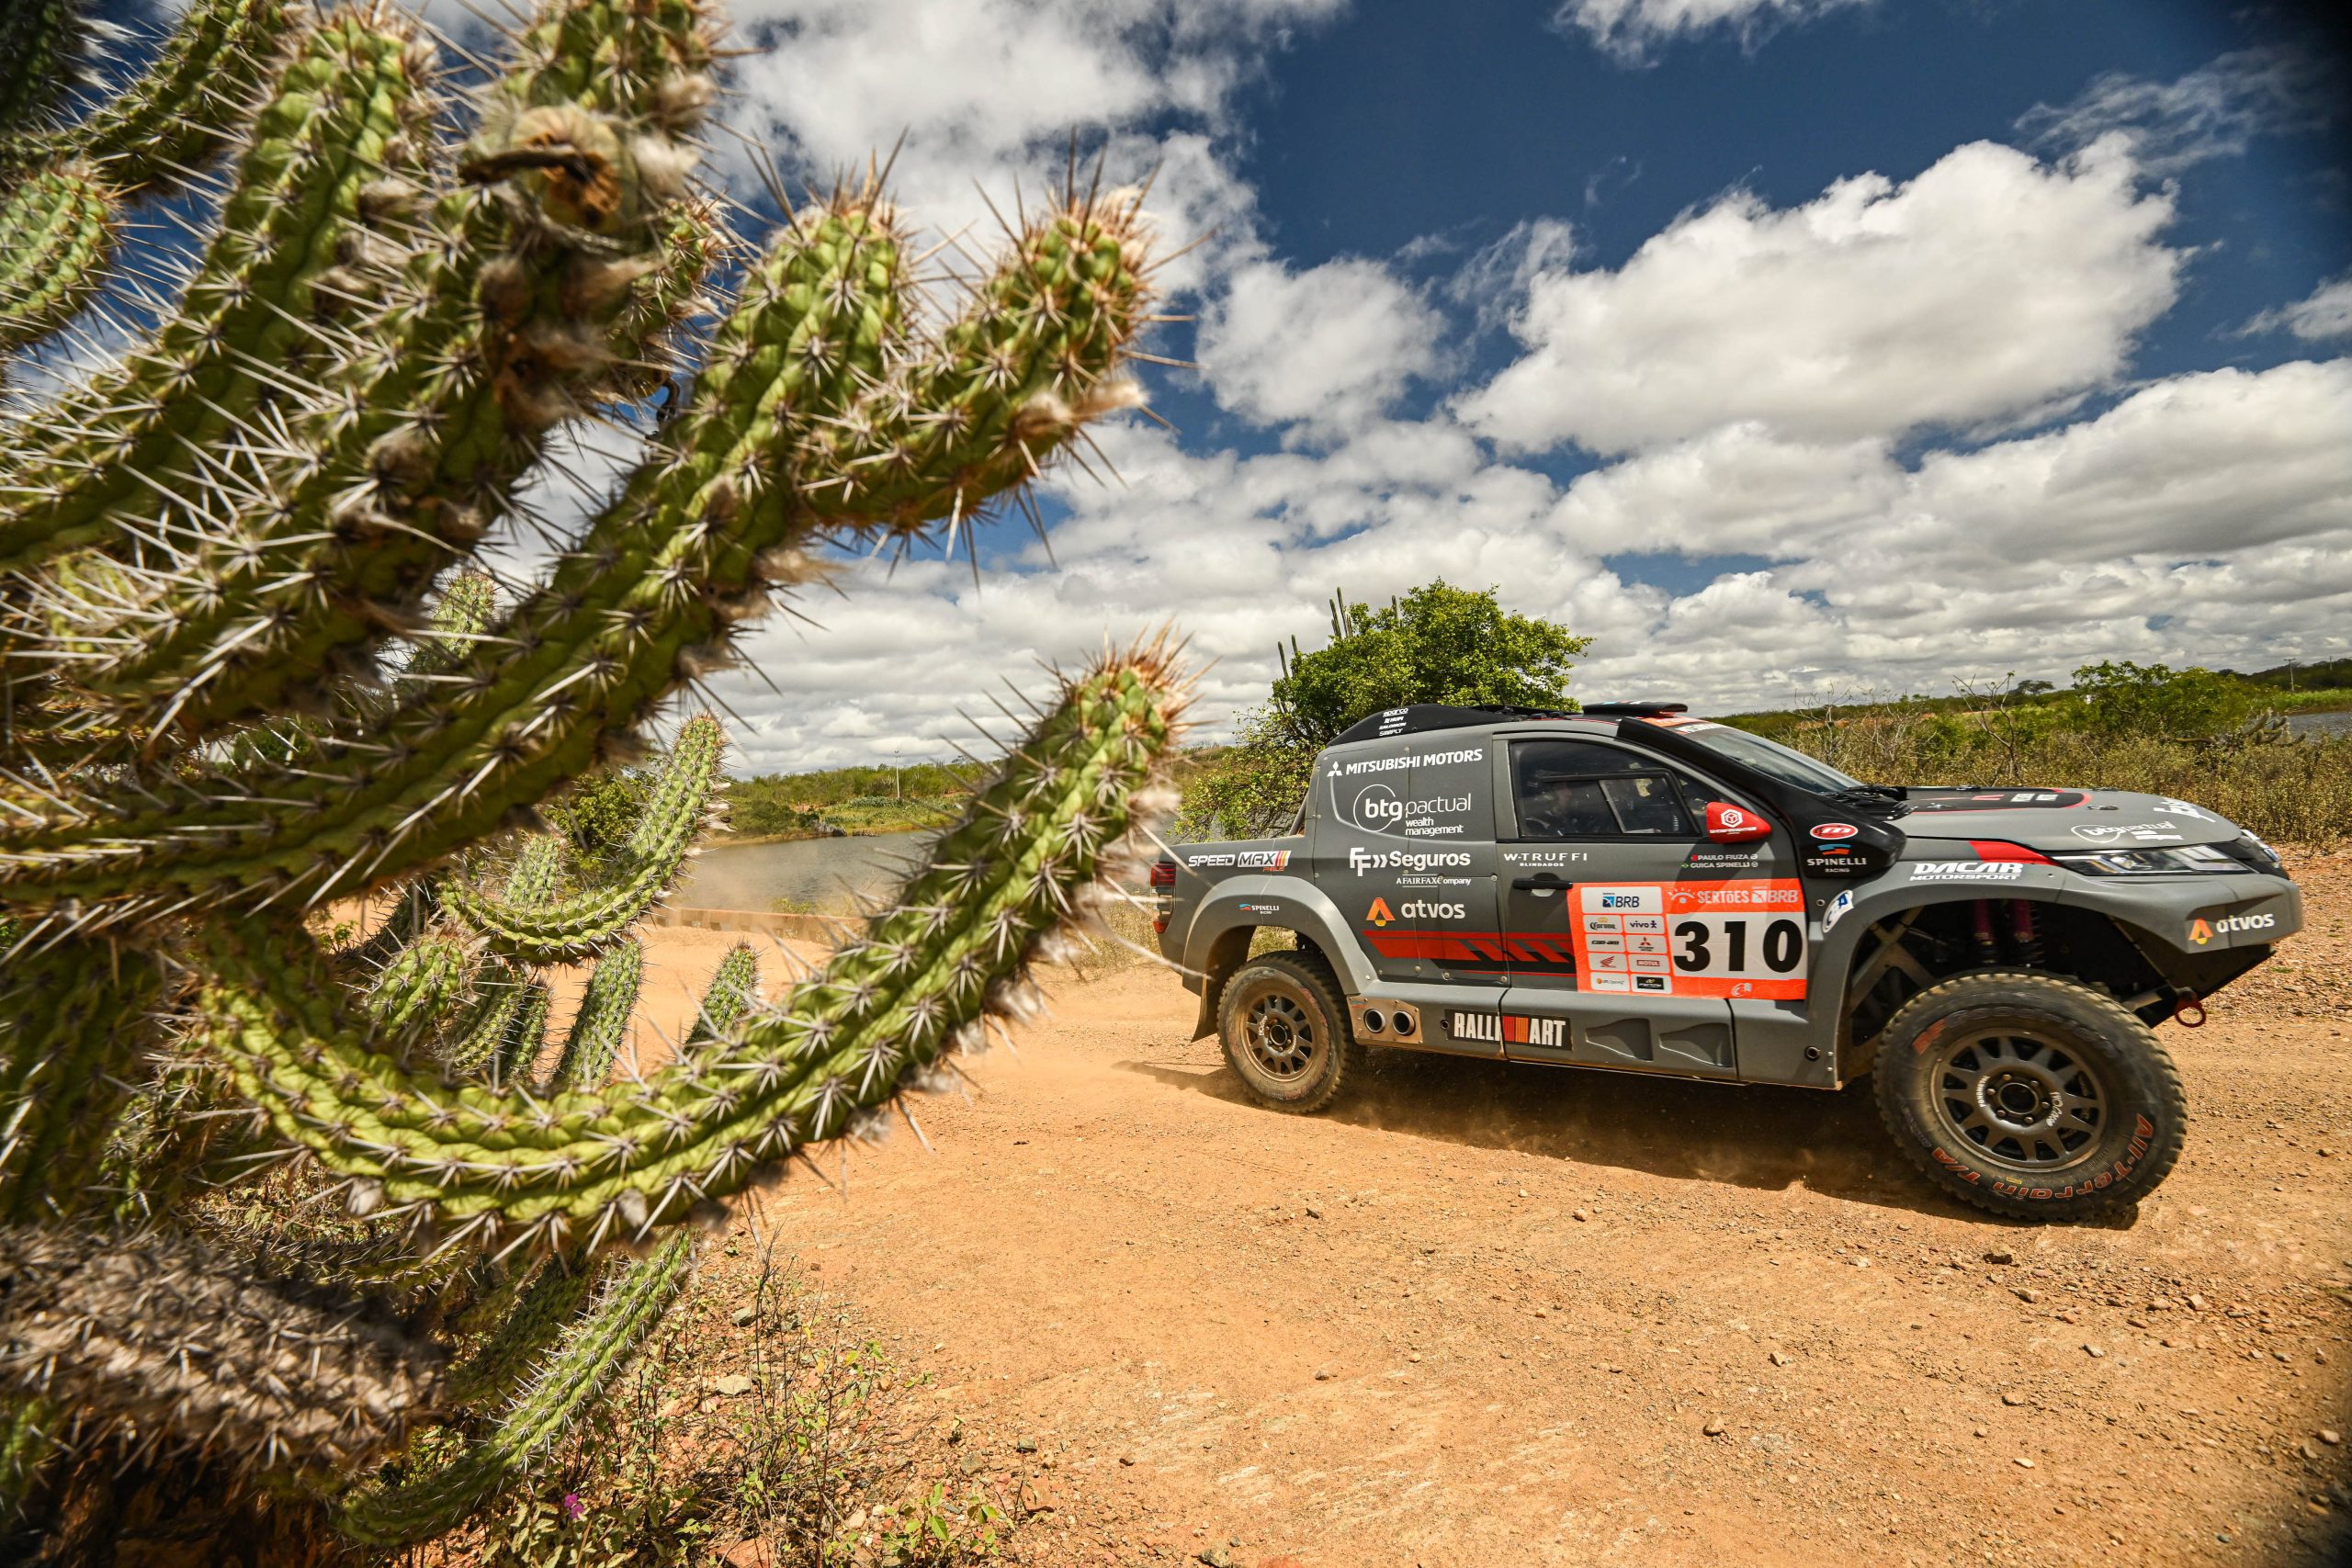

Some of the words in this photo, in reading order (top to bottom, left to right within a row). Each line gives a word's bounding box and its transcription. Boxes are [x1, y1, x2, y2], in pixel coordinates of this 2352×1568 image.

[1346, 755, 1420, 775] MITSUBISHI
[1423, 749, 1483, 766] MOTORS
[1365, 798, 1402, 821] btg
[1406, 793, 1472, 818] pactual
[1406, 817, 1434, 827] wealth
[1406, 825, 1464, 836] management
[1188, 854, 1236, 866] SPEED
[1239, 852, 1275, 865] MAX
[1389, 851, 1471, 871] Seguros
[1504, 852, 1588, 861] W-TRUFFI
[1806, 857, 1867, 865] SPINELLI
[1913, 863, 2022, 874] DACAR
[1403, 876, 1437, 885] FAIRFAX
[1616, 897, 1640, 908] BRB
[1768, 889, 1798, 903] BRB
[1401, 899, 1465, 919] atvos
[2216, 913, 2275, 933] atvos
[1673, 919, 1803, 973] 310
